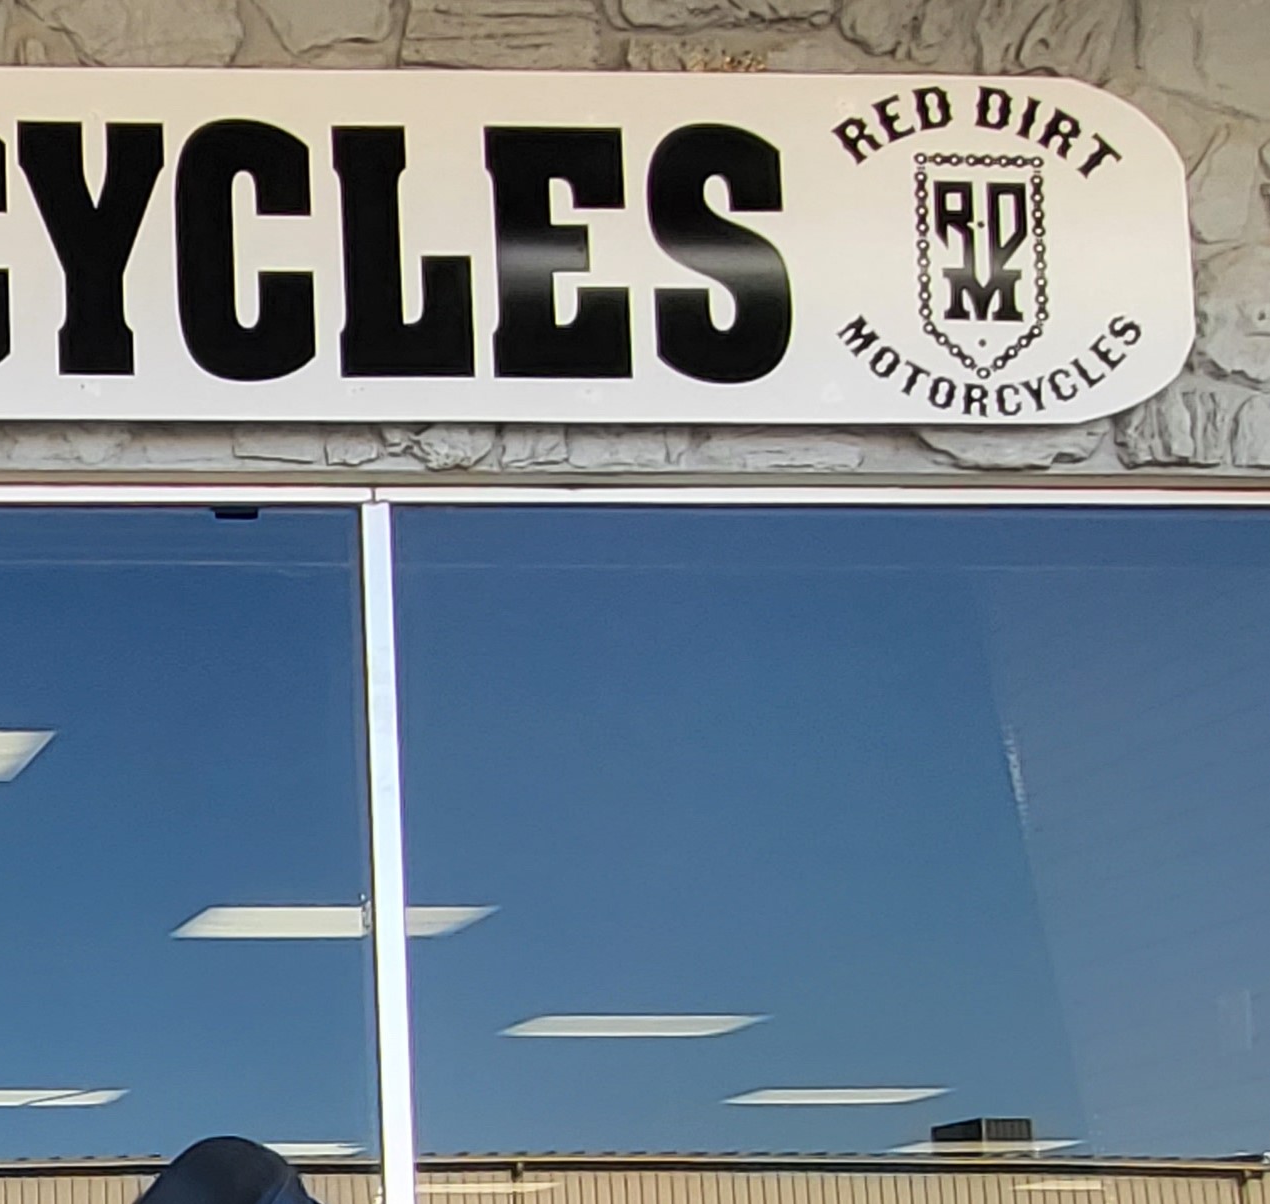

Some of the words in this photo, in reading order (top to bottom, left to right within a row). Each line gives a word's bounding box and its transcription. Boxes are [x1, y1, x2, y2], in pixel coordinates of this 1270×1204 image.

[831, 86, 953, 165] RED
[975, 86, 1122, 179] DIRT
[836, 314, 1142, 417] MOTORCYCLES
